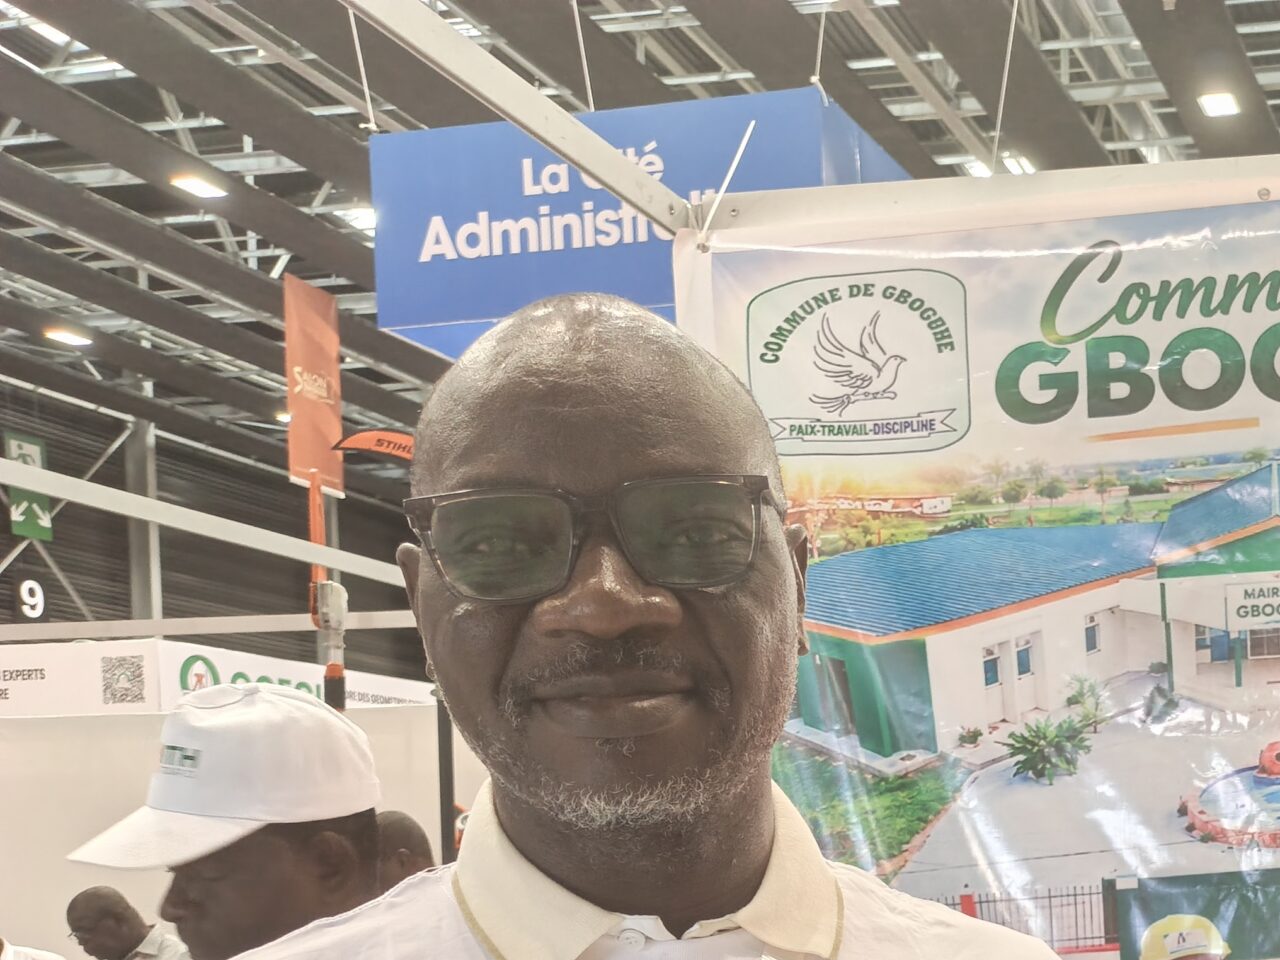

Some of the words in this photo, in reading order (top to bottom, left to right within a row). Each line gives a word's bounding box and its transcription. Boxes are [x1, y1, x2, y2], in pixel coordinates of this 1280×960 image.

[521, 158, 570, 196] La
[759, 287, 843, 364] COMMUNE
[848, 283, 876, 299] DE
[19, 579, 45, 619] 9
[2, 668, 46, 682] EXPERTS
